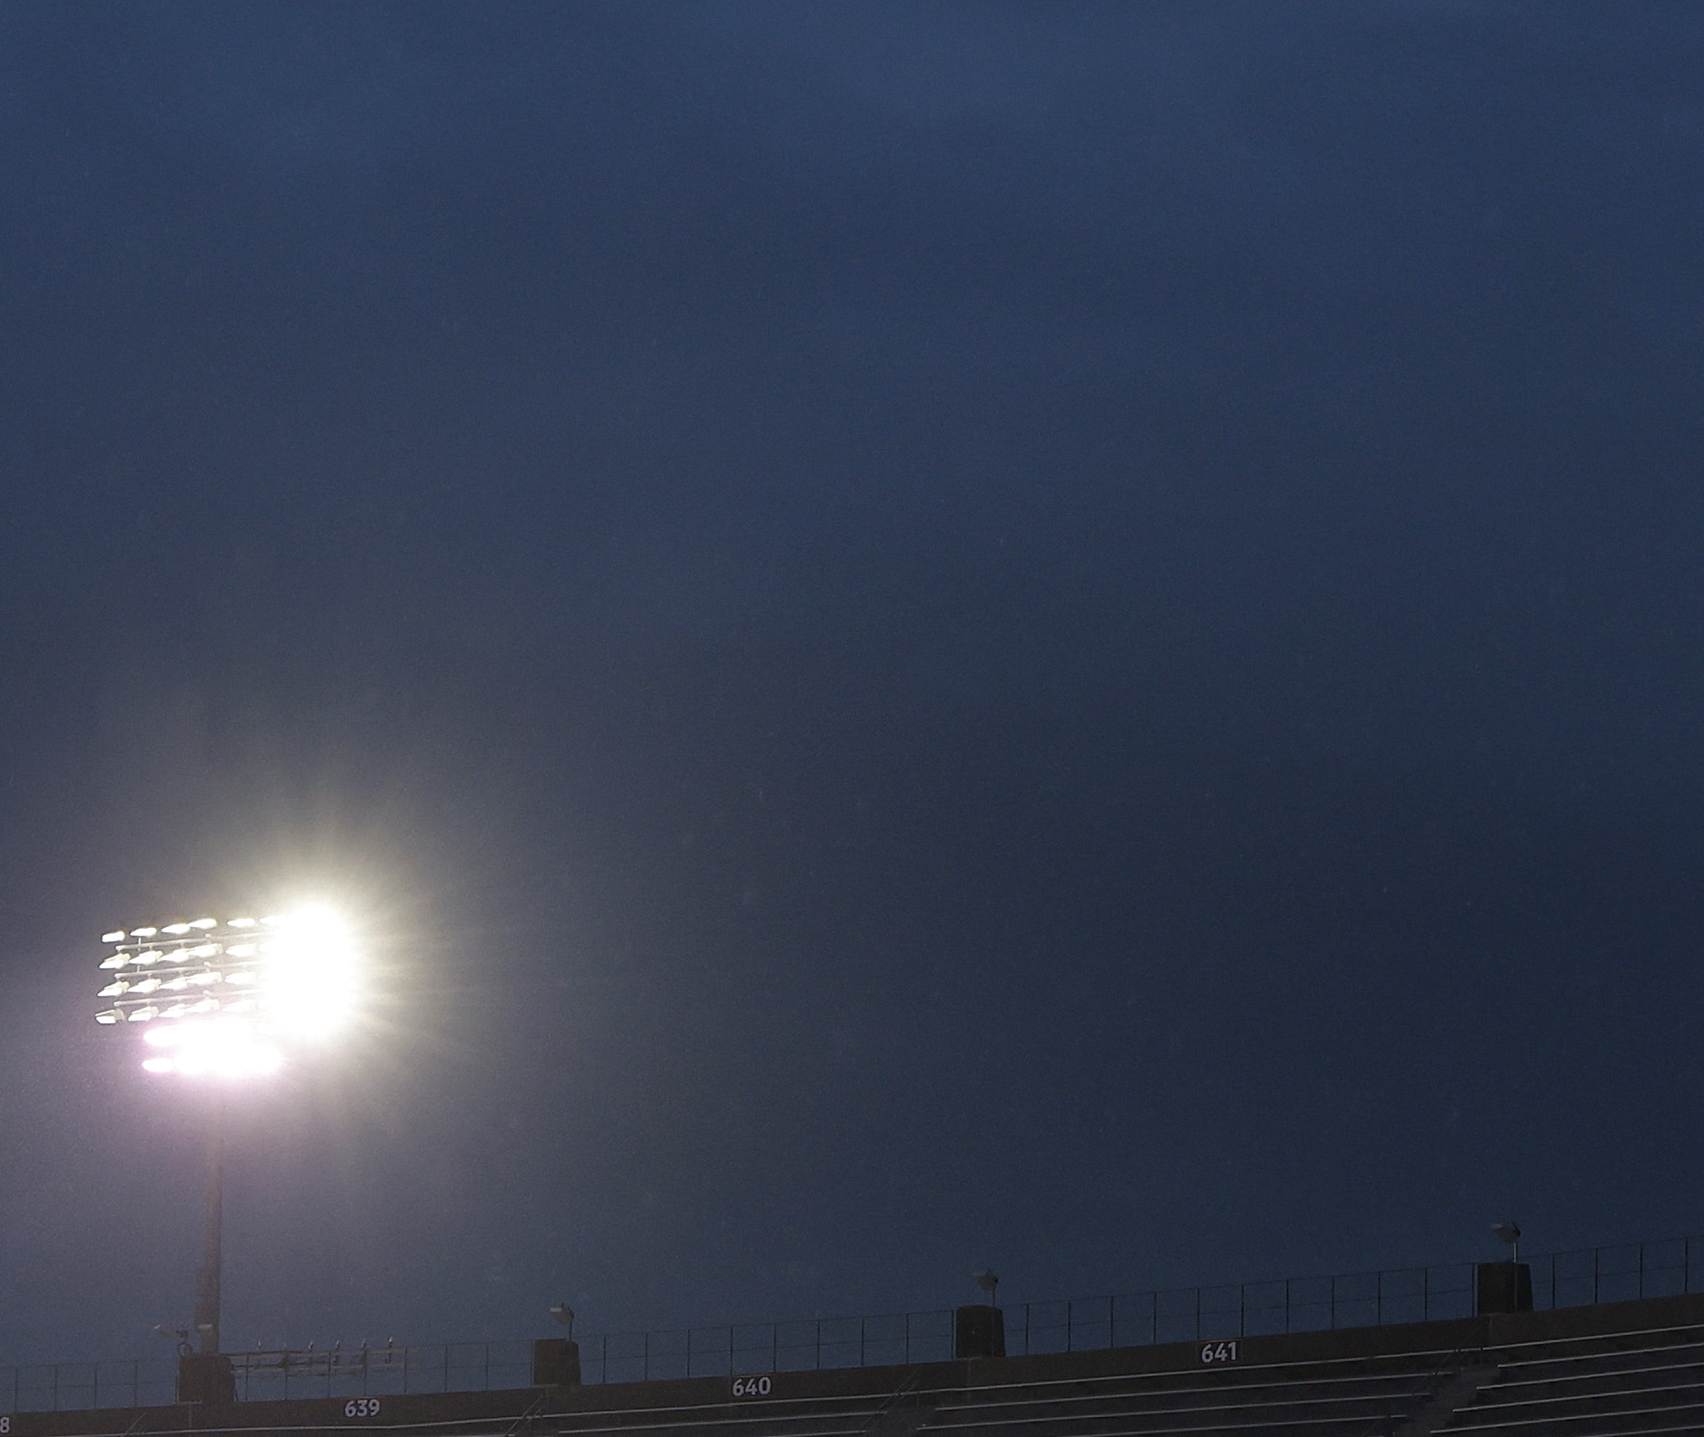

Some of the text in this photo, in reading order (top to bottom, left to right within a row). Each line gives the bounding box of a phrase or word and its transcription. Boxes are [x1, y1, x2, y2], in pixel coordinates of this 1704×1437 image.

[1201, 1341, 1237, 1363] 641
[732, 1376, 771, 1397] 640
[345, 1398, 380, 1417] 639
